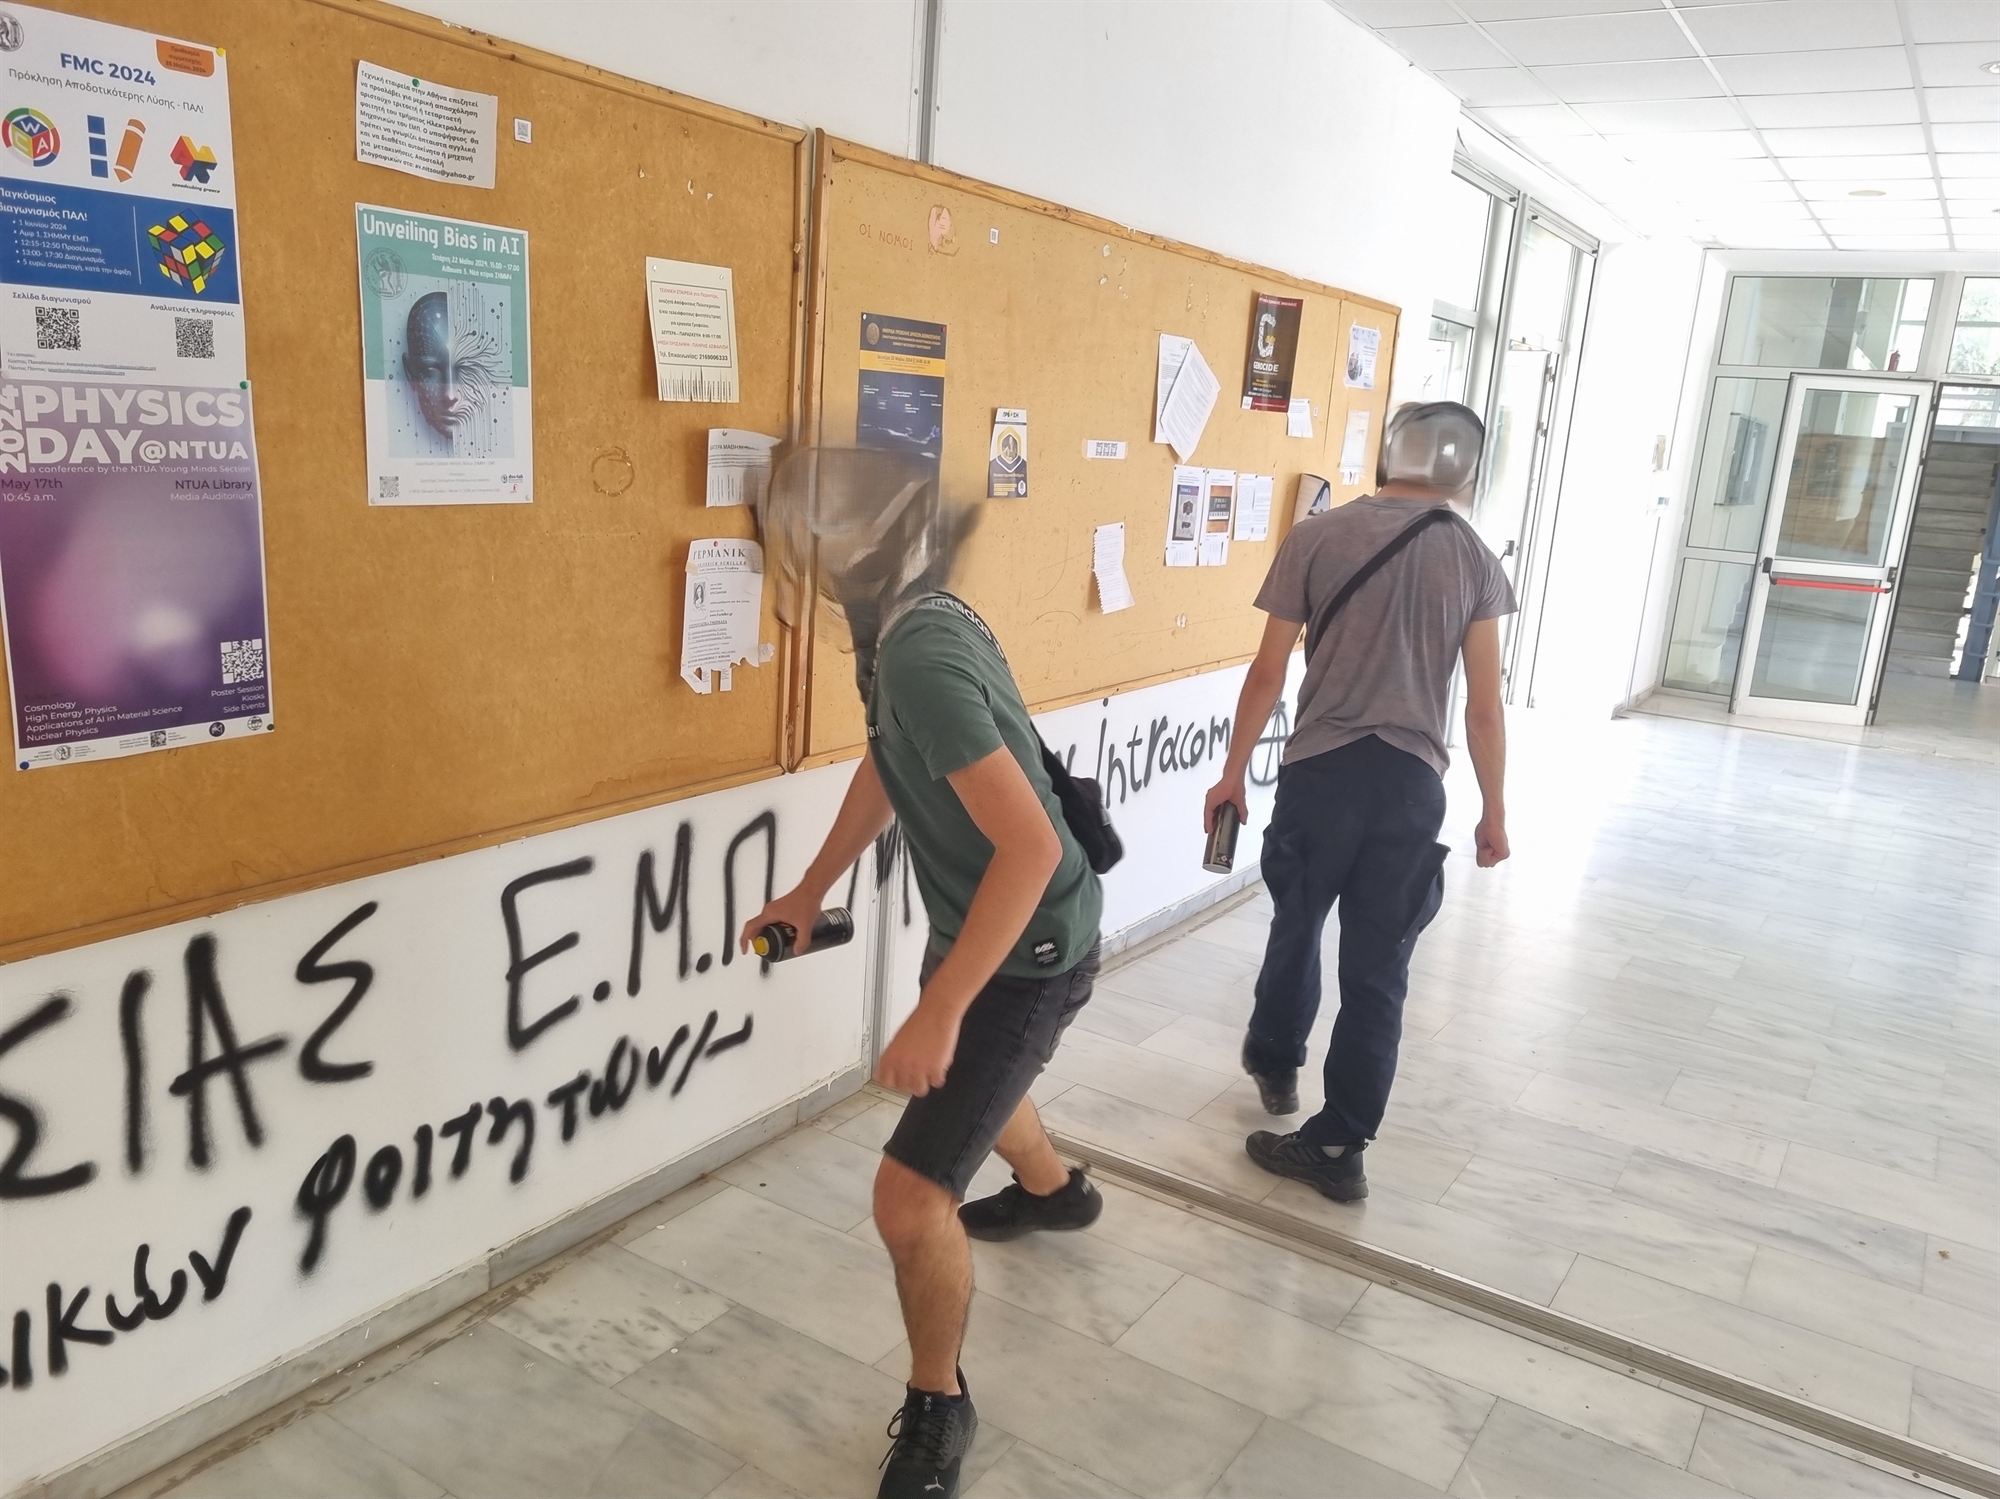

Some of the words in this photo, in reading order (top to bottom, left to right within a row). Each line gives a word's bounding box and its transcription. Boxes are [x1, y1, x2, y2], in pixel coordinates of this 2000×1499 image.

[60, 53, 104, 76] FMC
[108, 63, 156, 86] 2024
[9, 68, 63, 89] Πρόκληση
[64, 79, 145, 104] Αποδοτικότερης
[146, 94, 175, 110] Λύσης
[183, 101, 204, 114] ΠΑΛ!
[361, 69, 385, 84] Τεχνική
[385, 79, 411, 92] εταιρεία
[411, 87, 426, 97] στην
[426, 90, 448, 102] Αθήνα
[448, 97, 479, 109] επιζητεί
[360, 91, 392, 106] αριστούχο
[392, 100, 419, 114] τριτοετή
[424, 110, 463, 125] τεταρτοετή
[369, 83, 402, 99] προσλάβει
[402, 93, 413, 103] για
[412, 95, 434, 109] μερική
[434, 102, 478, 119] απασχόληση
[360, 101, 386, 116] φοιτητή
[386, 109, 398, 117] του
[398, 110, 426, 127] τμήματος
[426, 119, 477, 136] Ηλεκτρολόγων
[360, 110, 396, 125] Μηχανικών
[396, 120, 408, 129] του
[428, 130, 468, 145] υποψήφιος
[469, 137, 479, 146] θα
[360, 120, 382, 132] πρέπει
[392, 128, 417, 142] γνωρίζει
[417, 136, 448, 150] άπταιστα
[448, 143, 477, 155] αγγλικά
[360, 130, 371, 138] και
[380, 134, 407, 148] διαθέτει
[407, 142, 441, 157] αυτοκίνητο
[447, 151, 474, 163] μηχανή
[360, 140, 371, 148] για
[415, 152, 445, 168] Αποστολή
[360, 148, 402, 164] βιογραφικών
[415, 163, 476, 182] av.nitsou@yahoo.gr
[0, 187, 57, 204] Παγκόσμιος
[0, 202, 61, 219] διαγωνισμός
[62, 210, 88, 222] ΠΑΛ!
[24, 219, 49, 229] Ιουνίου
[50, 223, 67, 231] 2024
[43, 232, 71, 241] ΣΗΜΜΥ
[72, 234, 89, 242] ΕΜΠ
[363, 213, 438, 249] Unveiling
[444, 226, 478, 250] Bias
[483, 232, 496, 253] in
[499, 235, 520, 256] AI
[859, 223, 871, 239] ΟΙ
[879, 230, 914, 251] ΝΟΜΟΙ
[20, 239, 61, 249] 12:15-12:50
[28, 261, 46, 270] ευρώ
[45, 250, 64, 259] 17:30
[64, 253, 106, 264] Διαγωνισμός
[432, 252, 451, 266] Τετάρτη
[451, 256, 459, 265] 22
[507, 263, 520, 272] 17.00
[441, 264, 462, 276] Αίθουσα
[12, 291, 40, 302] Σελίδα
[41, 293, 92, 306] διαγωνισμού
[150, 303, 190, 316] Αναλυτικές
[191, 306, 236, 318] πληροφορίες
[1253, 361, 1279, 373] GENOCIDE
[21, 384, 246, 428] PHYSICS
[38, 465, 95, 474] conference
[97, 464, 109, 475] by
[112, 464, 128, 474] the
[130, 465, 158, 474] NTUA
[159, 464, 189, 475] Young
[190, 464, 218, 474] Minds
[219, 464, 251, 474] Section
[1, 478, 30, 491] May
[35, 478, 63, 490] 17th
[175, 479, 210, 491] NTUA
[212, 479, 253, 492] Library
[2, 492, 31, 502] 10:45
[33, 493, 57, 502] a.m.
[170, 492, 200, 501] Media
[202, 491, 254, 501] Auditorium
[211, 688, 236, 697] Poster
[237, 684, 265, 695] Session
[241, 692, 266, 702] Kiosks
[24, 700, 77, 714] Cosmology
[25, 711, 48, 724] High
[50, 708, 83, 721] Energy
[84, 704, 118, 718] Physics
[222, 704, 239, 714] Side
[241, 701, 266, 711] Events
[26, 718, 84, 733] Applications
[84, 715, 95, 726] of
[95, 715, 105, 724] AI
[107, 714, 116, 722] in
[117, 709, 151, 721] Material
[152, 705, 183, 716] Science
[26, 729, 63, 743] Nuclear
[65, 726, 99, 739] Physics
